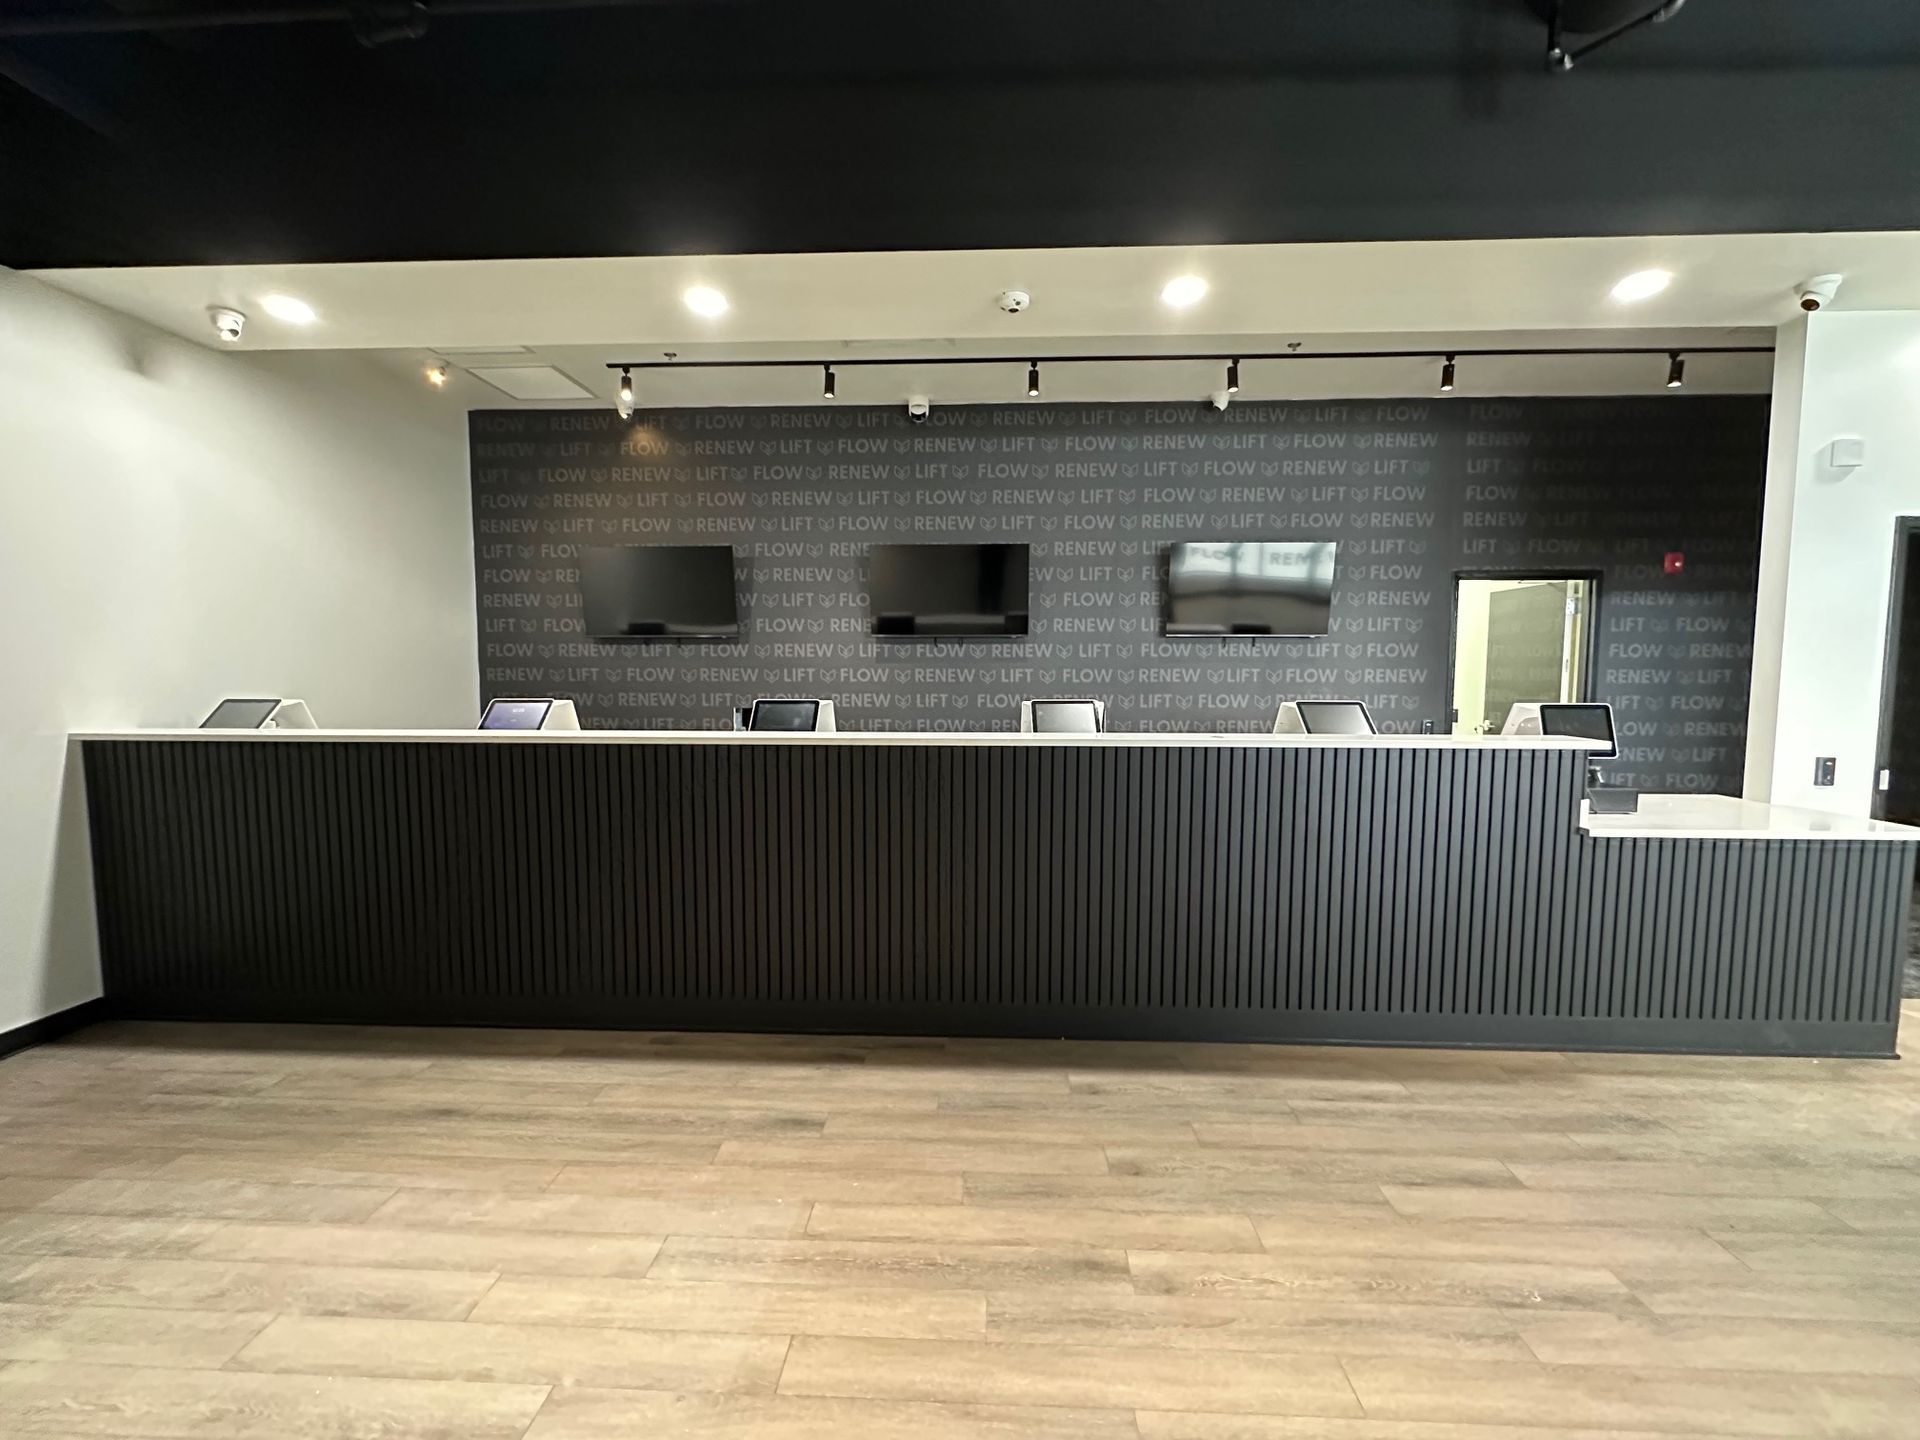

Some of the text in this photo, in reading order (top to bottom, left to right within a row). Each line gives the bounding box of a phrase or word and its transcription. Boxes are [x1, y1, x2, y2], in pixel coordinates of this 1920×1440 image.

[551, 416, 609, 431] RENEW
[696, 415, 744, 429] FLOW
[771, 412, 831, 428] RENEW
[857, 412, 889, 427] LIFT
[993, 410, 1055, 425] RENEW
[1082, 410, 1113, 424] LIFT
[1145, 408, 1196, 423] FLOW
[1224, 408, 1287, 423] RENEW
[1316, 407, 1348, 422] LIFT
[1377, 406, 1429, 421] FLOW
[560, 442, 591, 456] LIFT
[621, 441, 669, 456] FLOW
[695, 440, 753, 454] RENEW
[780, 439, 812, 454] LIFT
[838, 438, 888, 453] FLOW
[914, 437, 976, 452] RENEW
[1002, 437, 1035, 452] LIFT
[1065, 436, 1116, 451] FLOW
[1143, 435, 1206, 450] RENEW
[1233, 434, 1267, 449] LIFT
[1293, 434, 1346, 448] FLOW
[1374, 433, 1438, 448] RENEW
[1466, 432, 1531, 447] RENEW
[480, 459, 1409, 482] LIFT FLOW RENEW LIFT FLOW RENEW LIFT FLOW RENEW LIFT FLOW RENEW LIFT
[1466, 459, 1502, 474] LIFT
[481, 485, 1425, 508] FLOW RENEW LIFT FLOW RENEW LIFT FLOW RENEW LIFT FLOW RENEW LIFT FLOW
[1466, 486, 1518, 500] FLOW
[480, 512, 1434, 533] RENEW LIFT FLOW RENEW LIFT FLOW RENEW LIFT FLOW RENEW LIFT FLOW RENEW
[1463, 512, 1527, 527] RENEW
[483, 544, 513, 558] LIFT
[755, 542, 804, 557] FLOW
[830, 542, 870, 556] RENE
[1054, 541, 1115, 556] RENEW
[1370, 539, 1405, 554] LIFT
[1463, 539, 1582, 554] LIFT FLOW
[483, 565, 1422, 582] FLOW RENEW LIFT FLOW
[484, 592, 1430, 608] RENEW LIFT FLO FLOW RENEW
[1610, 591, 1675, 606] RENEW
[485, 619, 515, 632] LIFT
[757, 618, 803, 633] FLOW
[830, 618, 870, 632] RENE
[1054, 617, 1115, 632] RENEW
[1368, 617, 1402, 632] LIFT
[1611, 617, 1729, 632] LIFT FLOW
[487, 642, 1418, 657] FLOW RENEW LIFT FLOW RENEW LIFT FLOW RENEW LIFT FLOW RENEW LIFT FLOW
[1610, 644, 1662, 658] FLOW
[486, 668, 1427, 682] RENEW LIFT FLOW RENEW LIFT FLOW RENEW LIFT FLOW RENEW LIFT FLOW RENEW
[1606, 670, 1733, 684] RENEW LIFT
[618, 693, 677, 707] RENEW
[701, 693, 733, 706] LIFT
[916, 694, 948, 708] LIFT
[1140, 694, 1172, 708] LIFT
[1199, 694, 1250, 708] FLOW
[1670, 695, 1724, 709] FLOW
[581, 719, 619, 730] NEW
[643, 718, 674, 730] LIFT
[702, 719, 731, 730] FLO
[860, 719, 889, 732] LIFT
[916, 719, 966, 732] FLOW
[992, 719, 1020, 731] REN
[1139, 720, 1190, 732] FLOW
[1616, 722, 1657, 736] LOW
[1692, 748, 1726, 761] LIFT
[1666, 773, 1718, 788] FLOW
